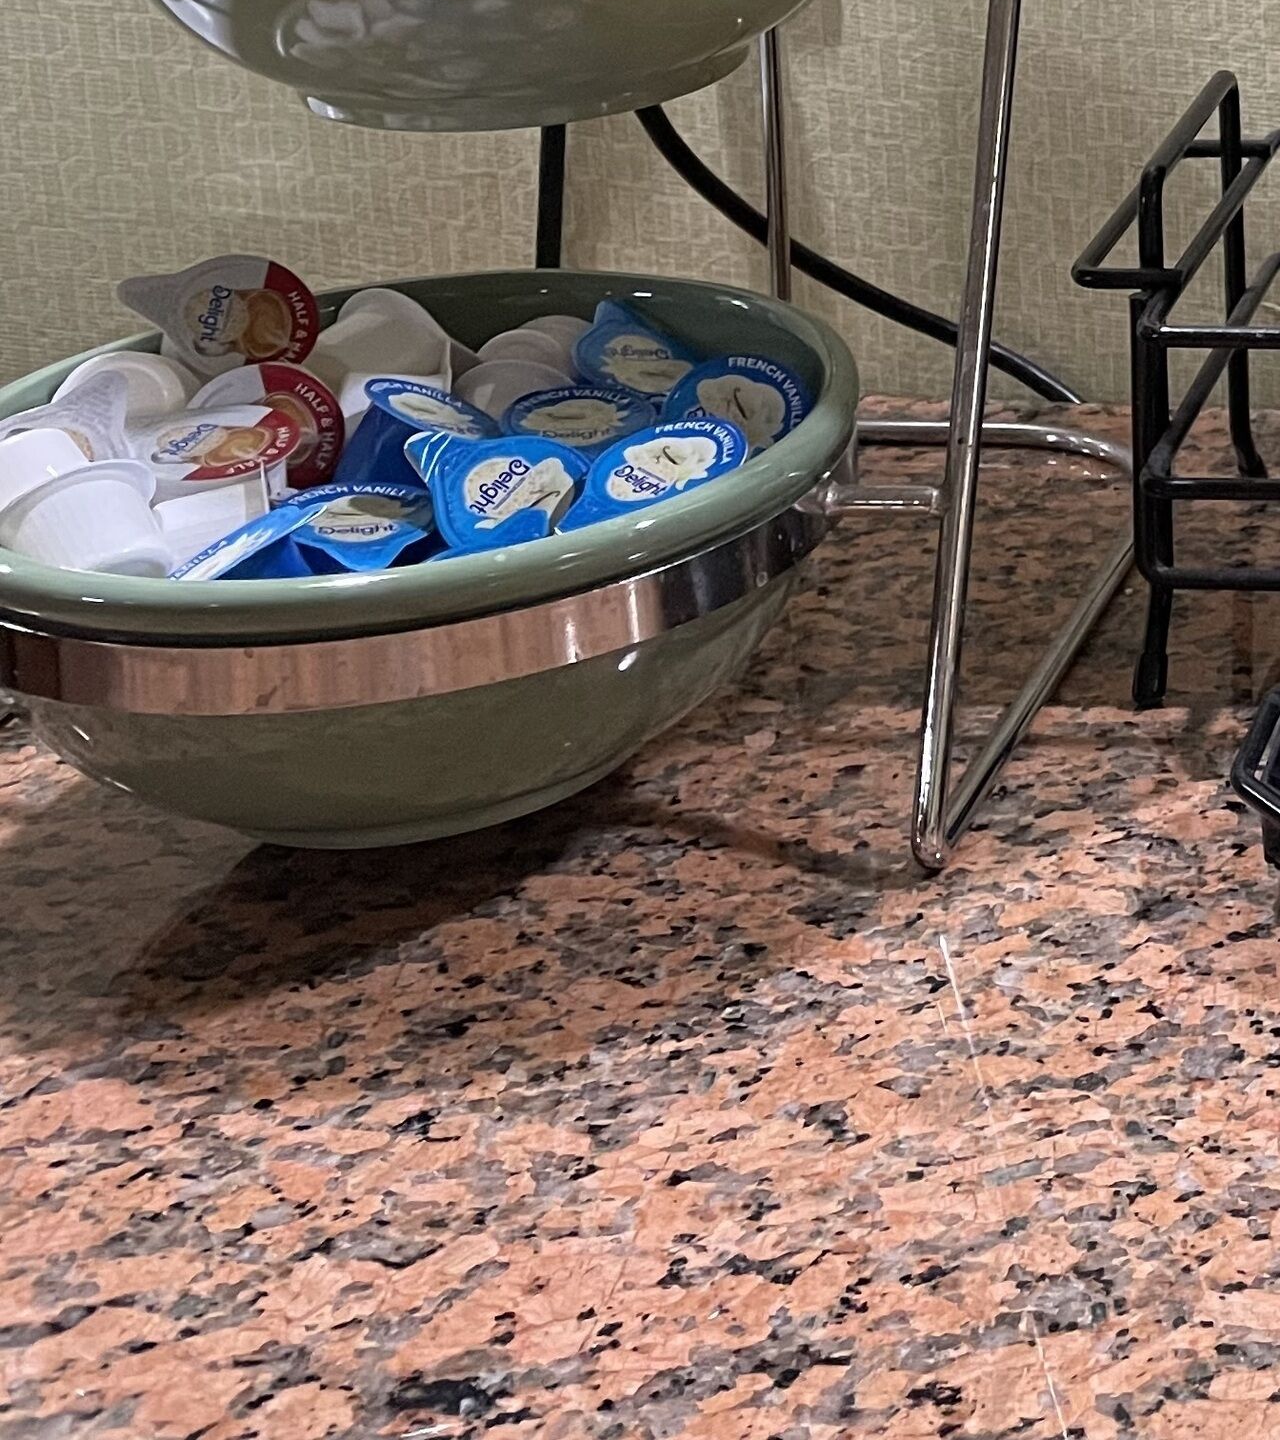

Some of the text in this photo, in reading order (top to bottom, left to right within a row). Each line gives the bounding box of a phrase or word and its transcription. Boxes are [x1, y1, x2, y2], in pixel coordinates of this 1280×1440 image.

[199, 285, 233, 343] Delight
[288, 291, 310, 324] HALF
[293, 330, 309, 340] &
[727, 356, 805, 430] FRENCH VANILL
[294, 382, 338, 470] HALF & HALF
[654, 421, 736, 466] FRENCH VANILLA
[288, 484, 350, 506] FRENCH
[468, 458, 531, 514] Delight
[613, 464, 669, 497] Delight
[317, 523, 396, 536] Delight
